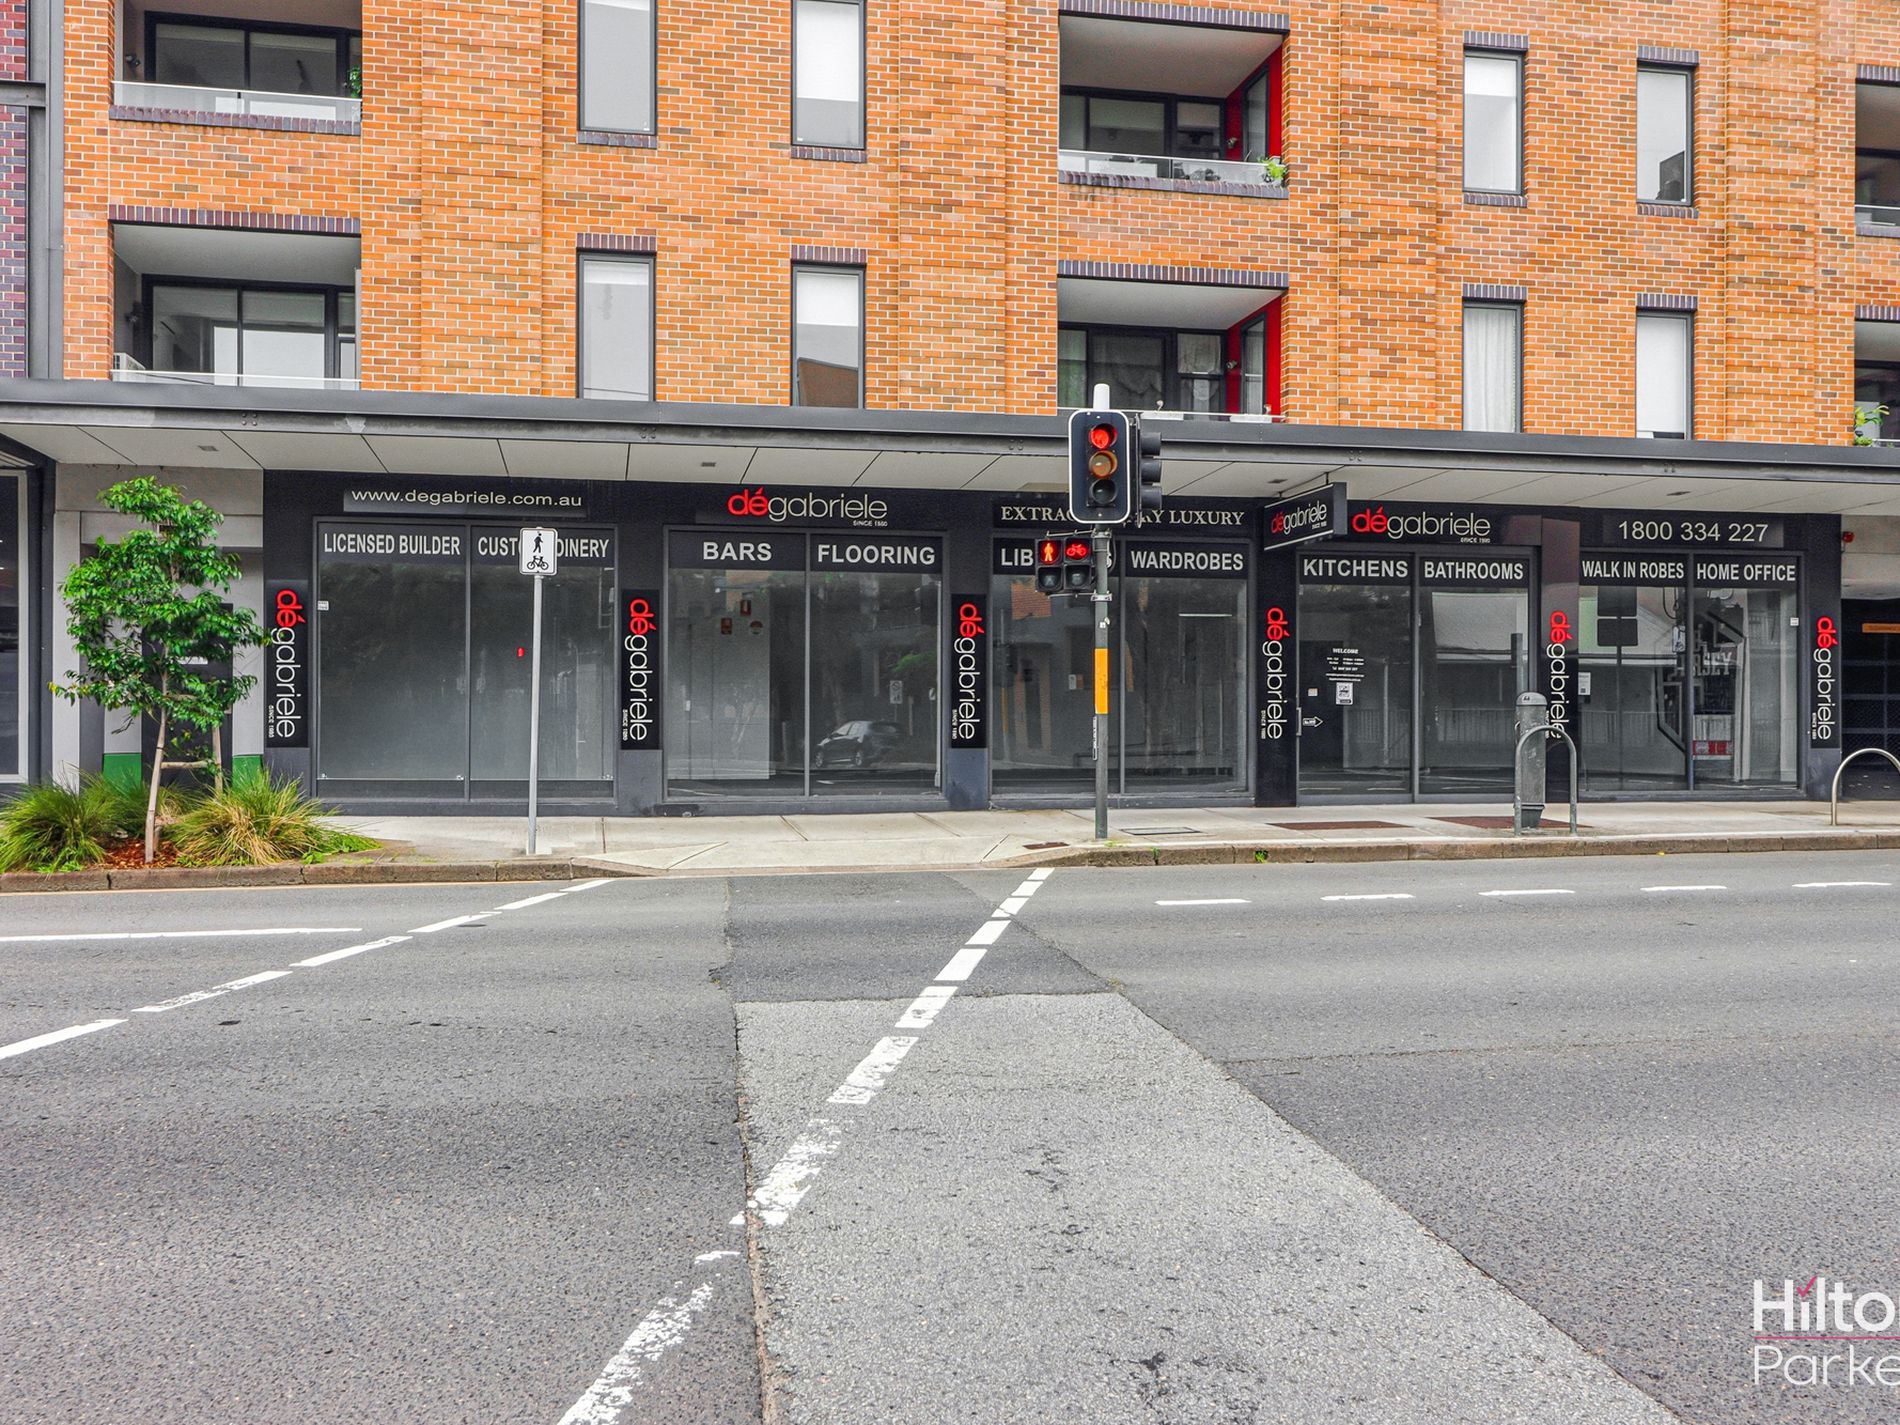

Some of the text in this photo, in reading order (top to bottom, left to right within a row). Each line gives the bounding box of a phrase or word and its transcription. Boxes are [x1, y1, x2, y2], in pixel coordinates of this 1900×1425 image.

[351, 488, 582, 507] www.degabriele.com.au
[726, 487, 888, 523] dégabriele
[1169, 509, 1245, 527] LUXURY
[1271, 500, 1327, 535] dégabriele
[1351, 505, 1491, 539] dégabriele
[1619, 520, 1769, 543] 1800 334 227
[323, 532, 461, 556] LICENSED BUILDER
[557, 537, 610, 558] OINERY
[702, 541, 773, 561] BARS
[817, 543, 936, 566] FLOORING
[1130, 550, 1244, 571] WARDROBES
[1303, 558, 1409, 578] KITCHENS
[1424, 561, 1524, 580] BATHROOMS
[1582, 560, 1684, 579] WALK IN ROBES
[1697, 563, 1796, 581] HOME OFFICE
[270, 589, 308, 738] dégabriele
[624, 598, 657, 741] dégabriele
[954, 603, 985, 740] dégabriele
[1262, 607, 1290, 740] dégabriele
[1813, 616, 1839, 740] dégabriele
